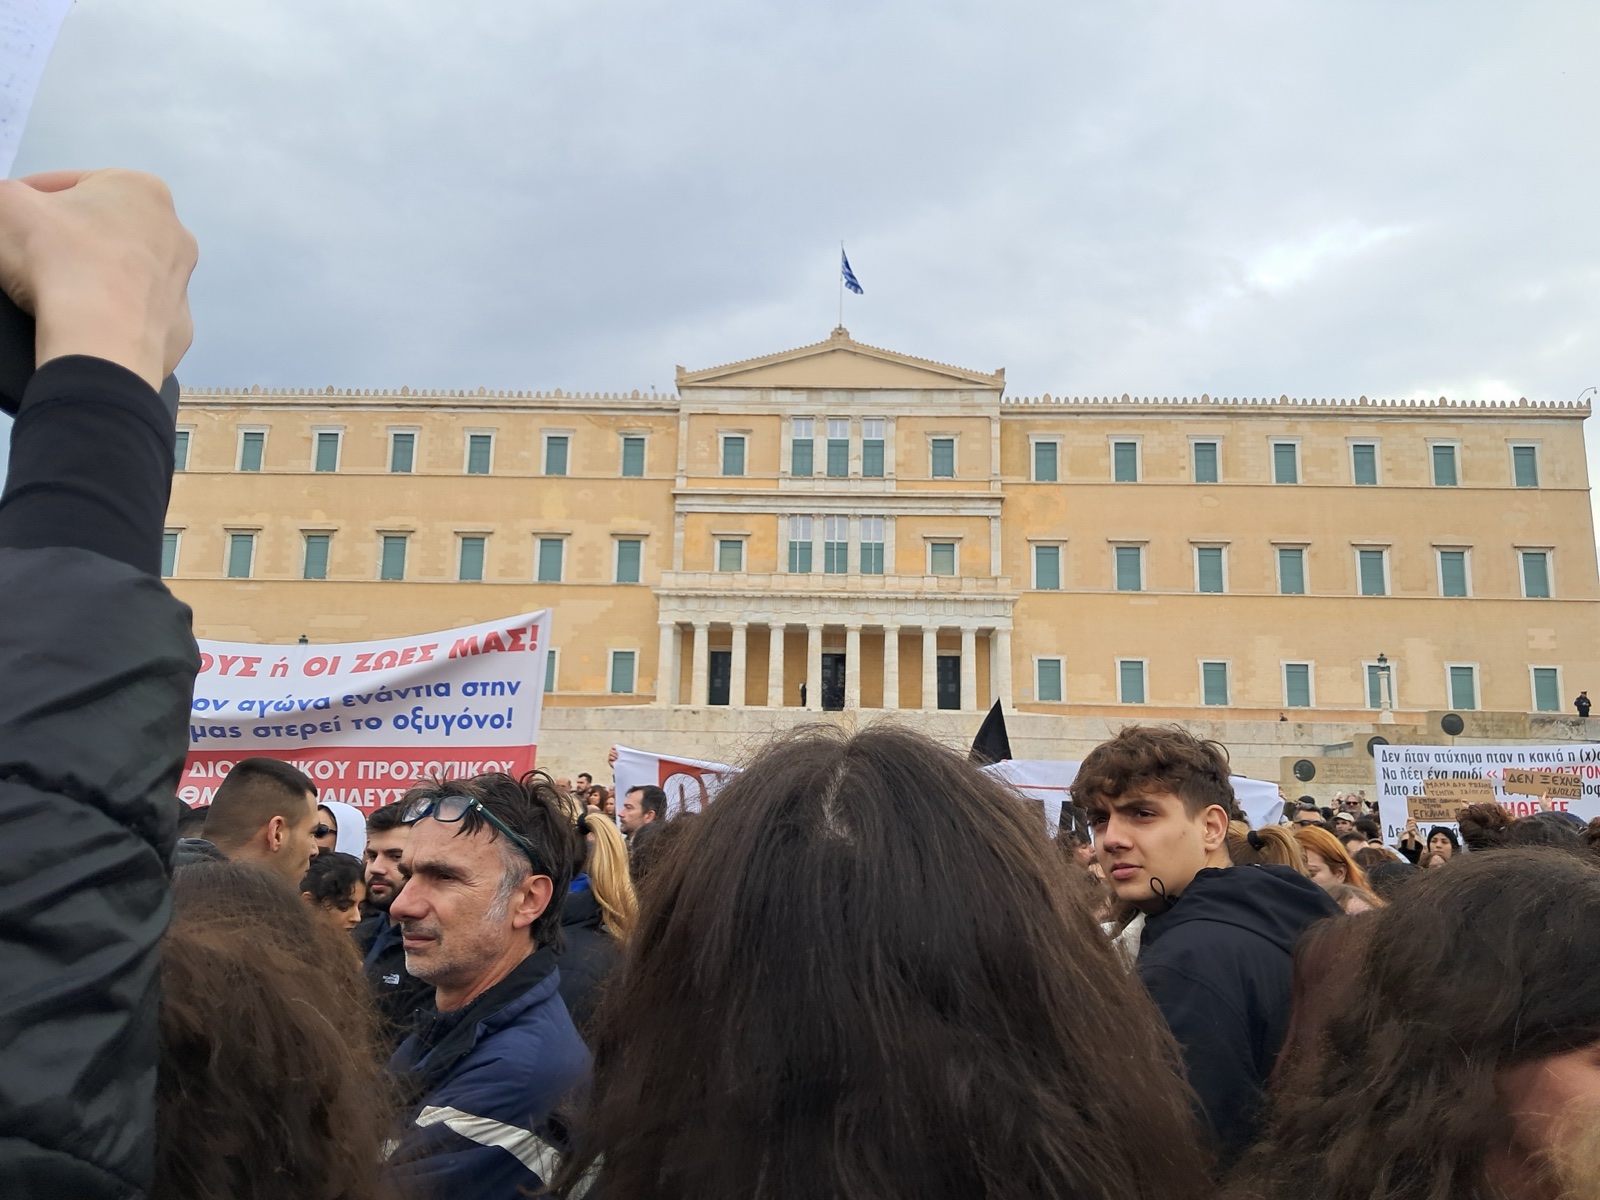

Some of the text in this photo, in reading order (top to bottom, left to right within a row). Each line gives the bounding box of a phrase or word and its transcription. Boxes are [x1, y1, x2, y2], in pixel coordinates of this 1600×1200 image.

[270, 656, 289, 677] ή
[303, 656, 341, 677] ΟΙ
[350, 643, 439, 674] ΖΩΕΣ
[448, 624, 539, 659] ΜΑΣ!
[237, 693, 330, 718] αγώνα
[342, 681, 450, 708] ενάντια
[461, 680, 521, 698] στην
[190, 705, 513, 742] μας στερεί το οξυγόνο!
[1381, 749, 1400, 763] Δεν
[1404, 749, 1430, 763] ήταν
[1434, 749, 1482, 766] ατύχημα
[1486, 752, 1513, 763] ηταν
[1518, 753, 1525, 763] η
[1529, 748, 1564, 763] κακιά
[1568, 751, 1576, 762] η
[357, 760, 515, 781] ΠΡΟΣΩΠΙΚΟΥ
[1382, 766, 1397, 780] Να
[1400, 766, 1423, 780] λέει
[1427, 766, 1448, 780] ένα
[1452, 766, 1482, 780] παιδί
[1508, 773, 1534, 784] ΔΕΝ
[1384, 782, 1409, 796] Αυτο
